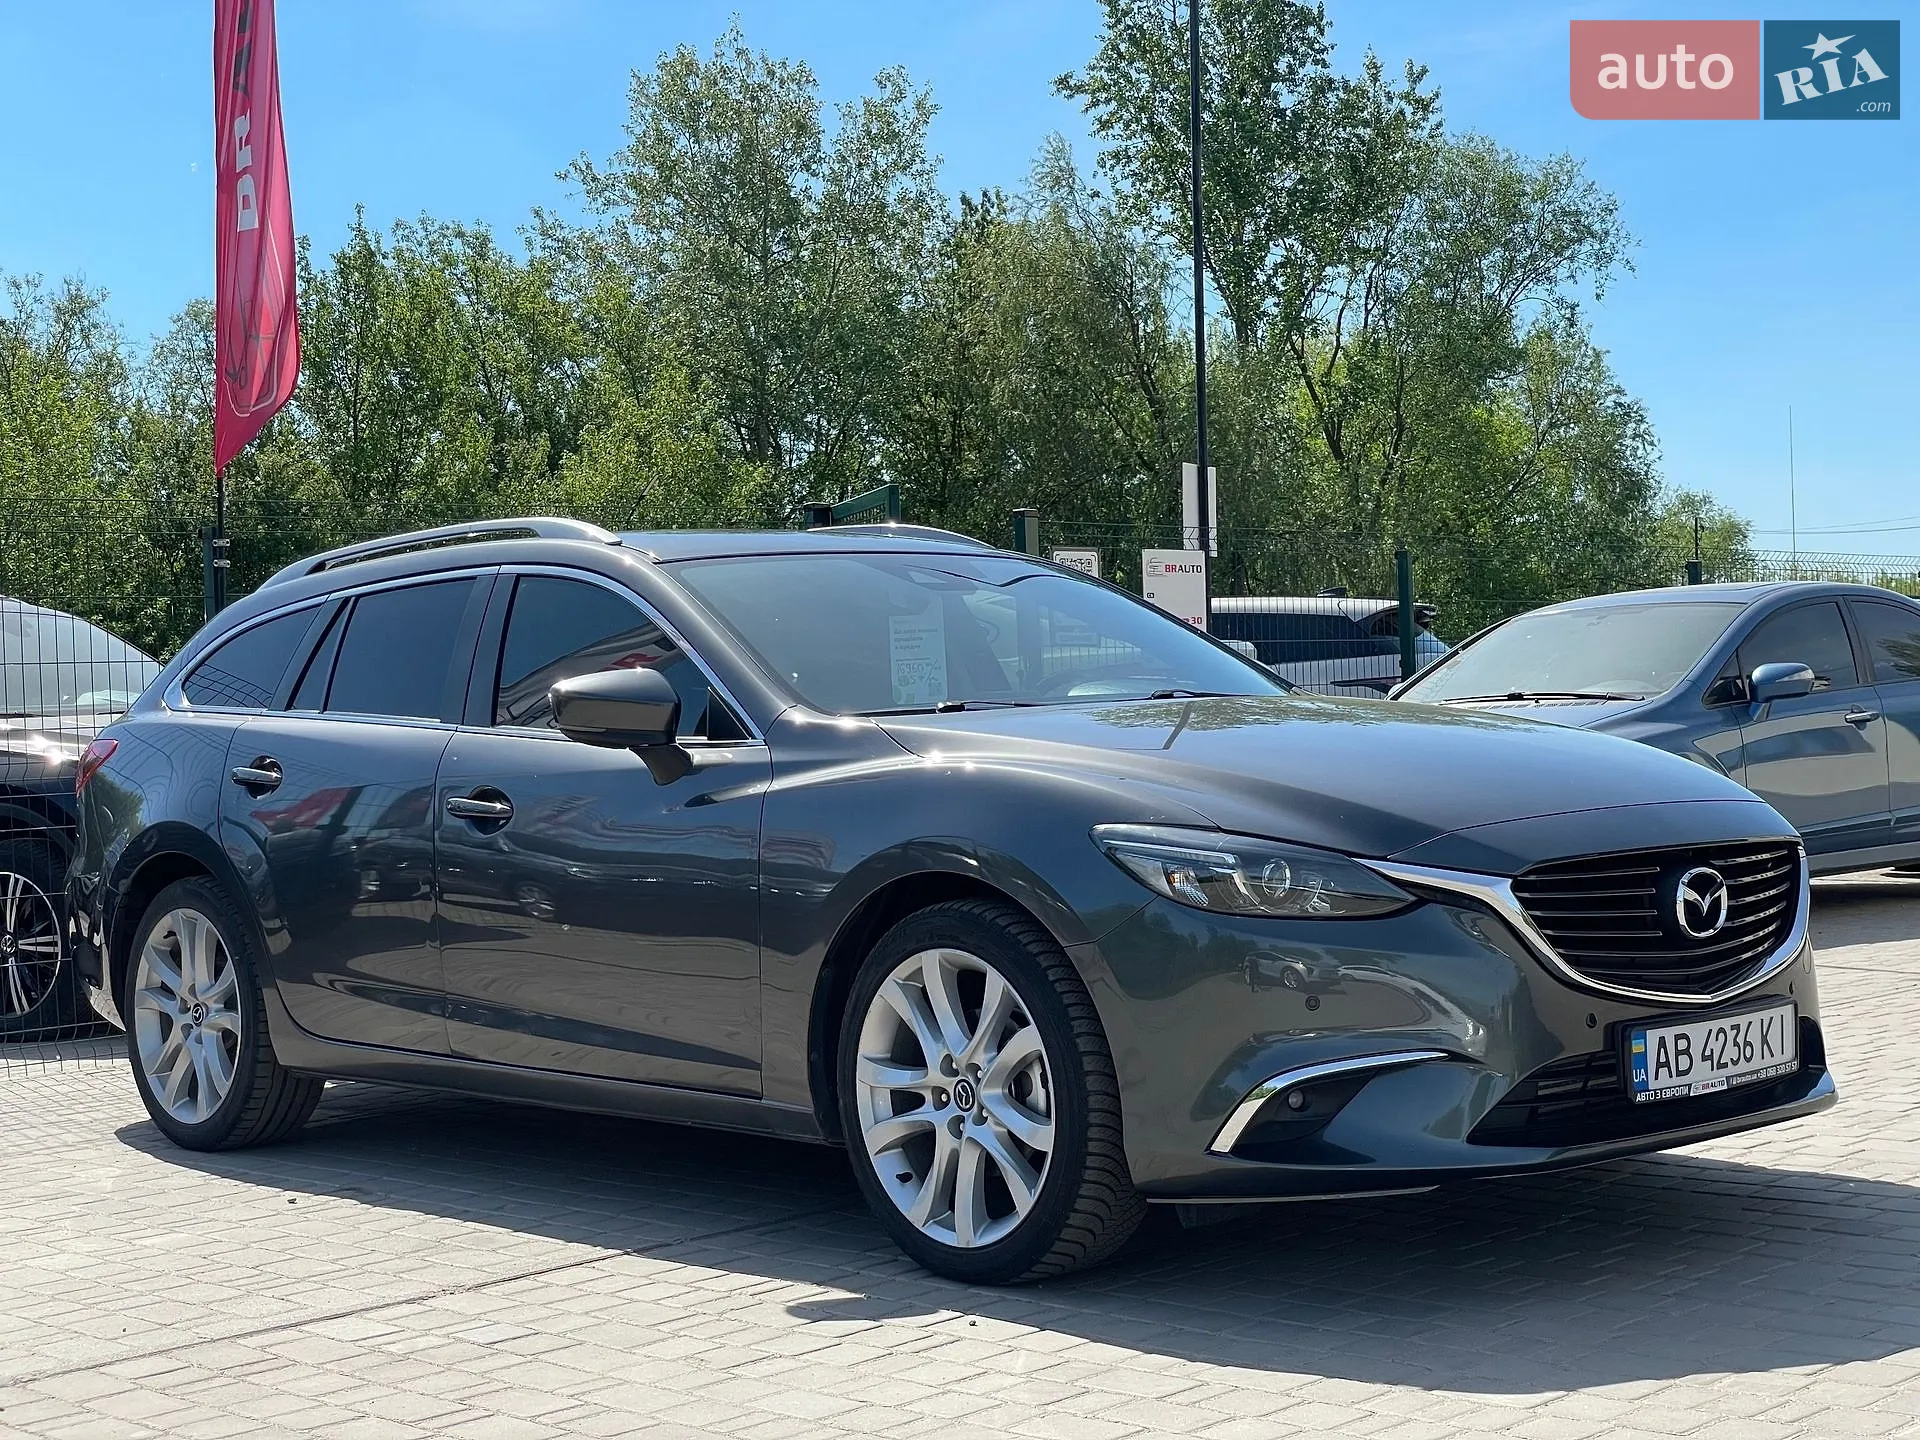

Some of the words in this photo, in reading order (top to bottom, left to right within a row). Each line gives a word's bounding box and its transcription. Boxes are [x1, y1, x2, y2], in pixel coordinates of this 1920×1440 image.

[1164, 564, 1202, 574] BRAUTO
[1654, 1032, 1694, 1081] AB
[1701, 1021, 1755, 1072] 4236
[1760, 1014, 1785, 1060] KI
[1633, 1068, 1647, 1083] UA
